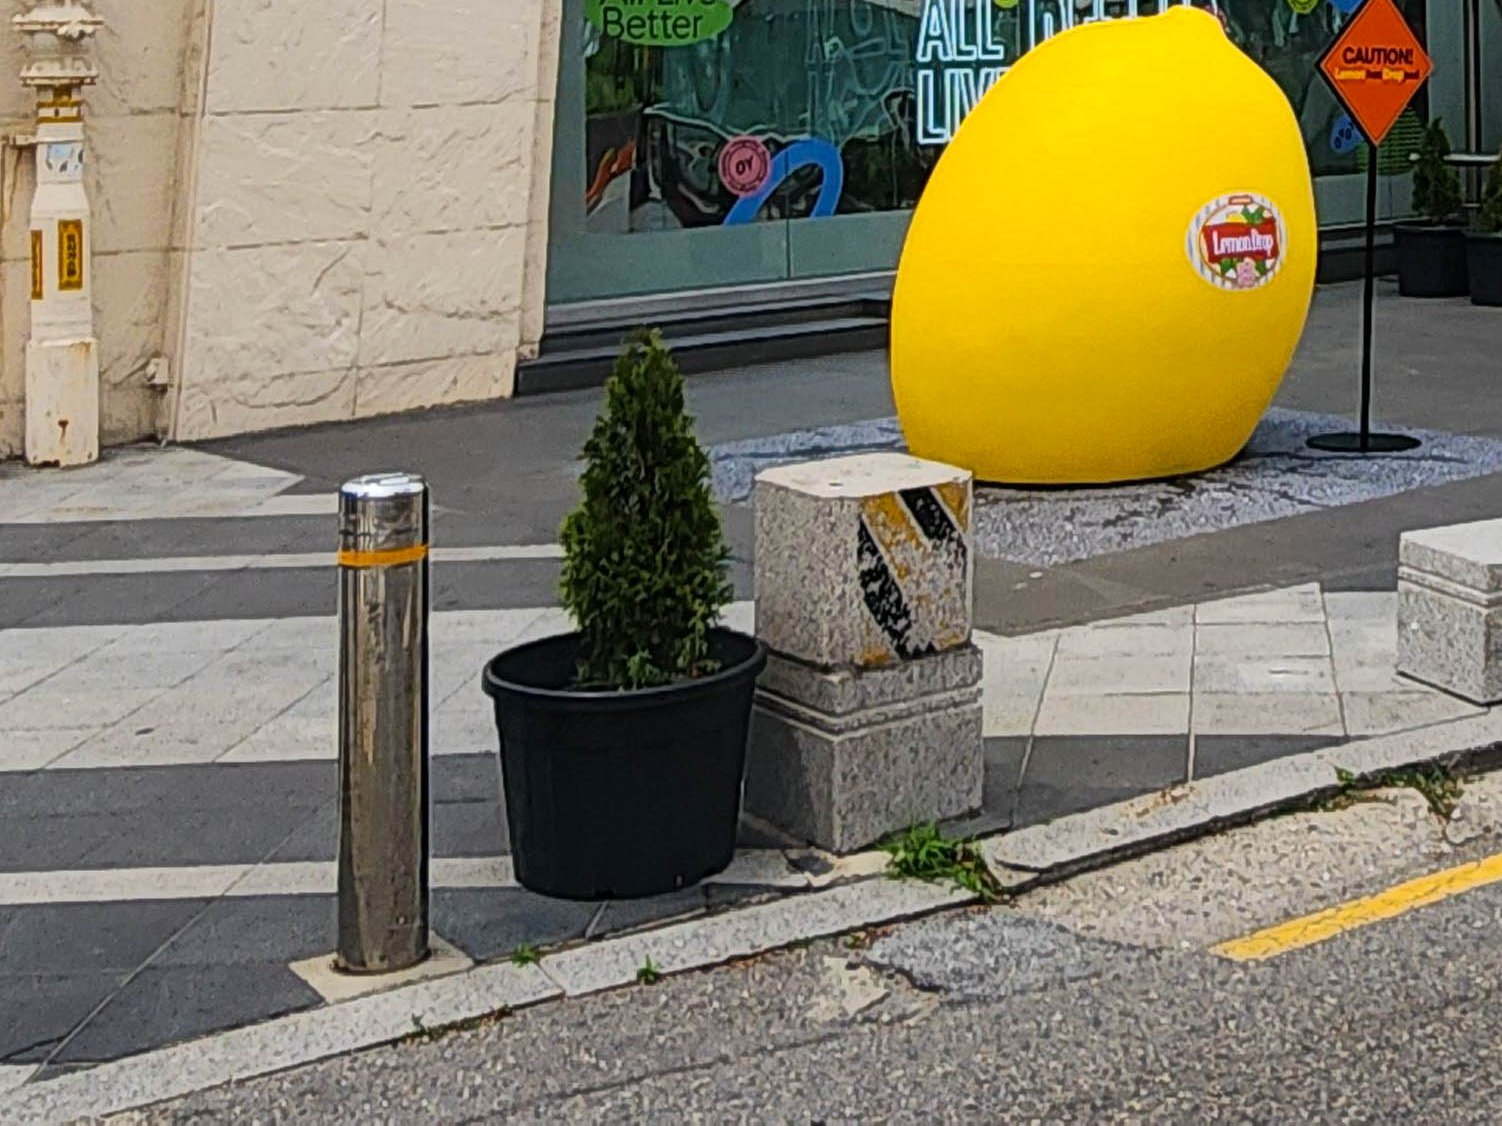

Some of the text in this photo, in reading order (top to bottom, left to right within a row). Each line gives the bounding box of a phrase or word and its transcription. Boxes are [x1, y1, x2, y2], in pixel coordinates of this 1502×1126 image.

[602, 7, 703, 39] Better
[1343, 46, 1413, 64] CAUTION!
[916, 67, 1009, 145] LIV
